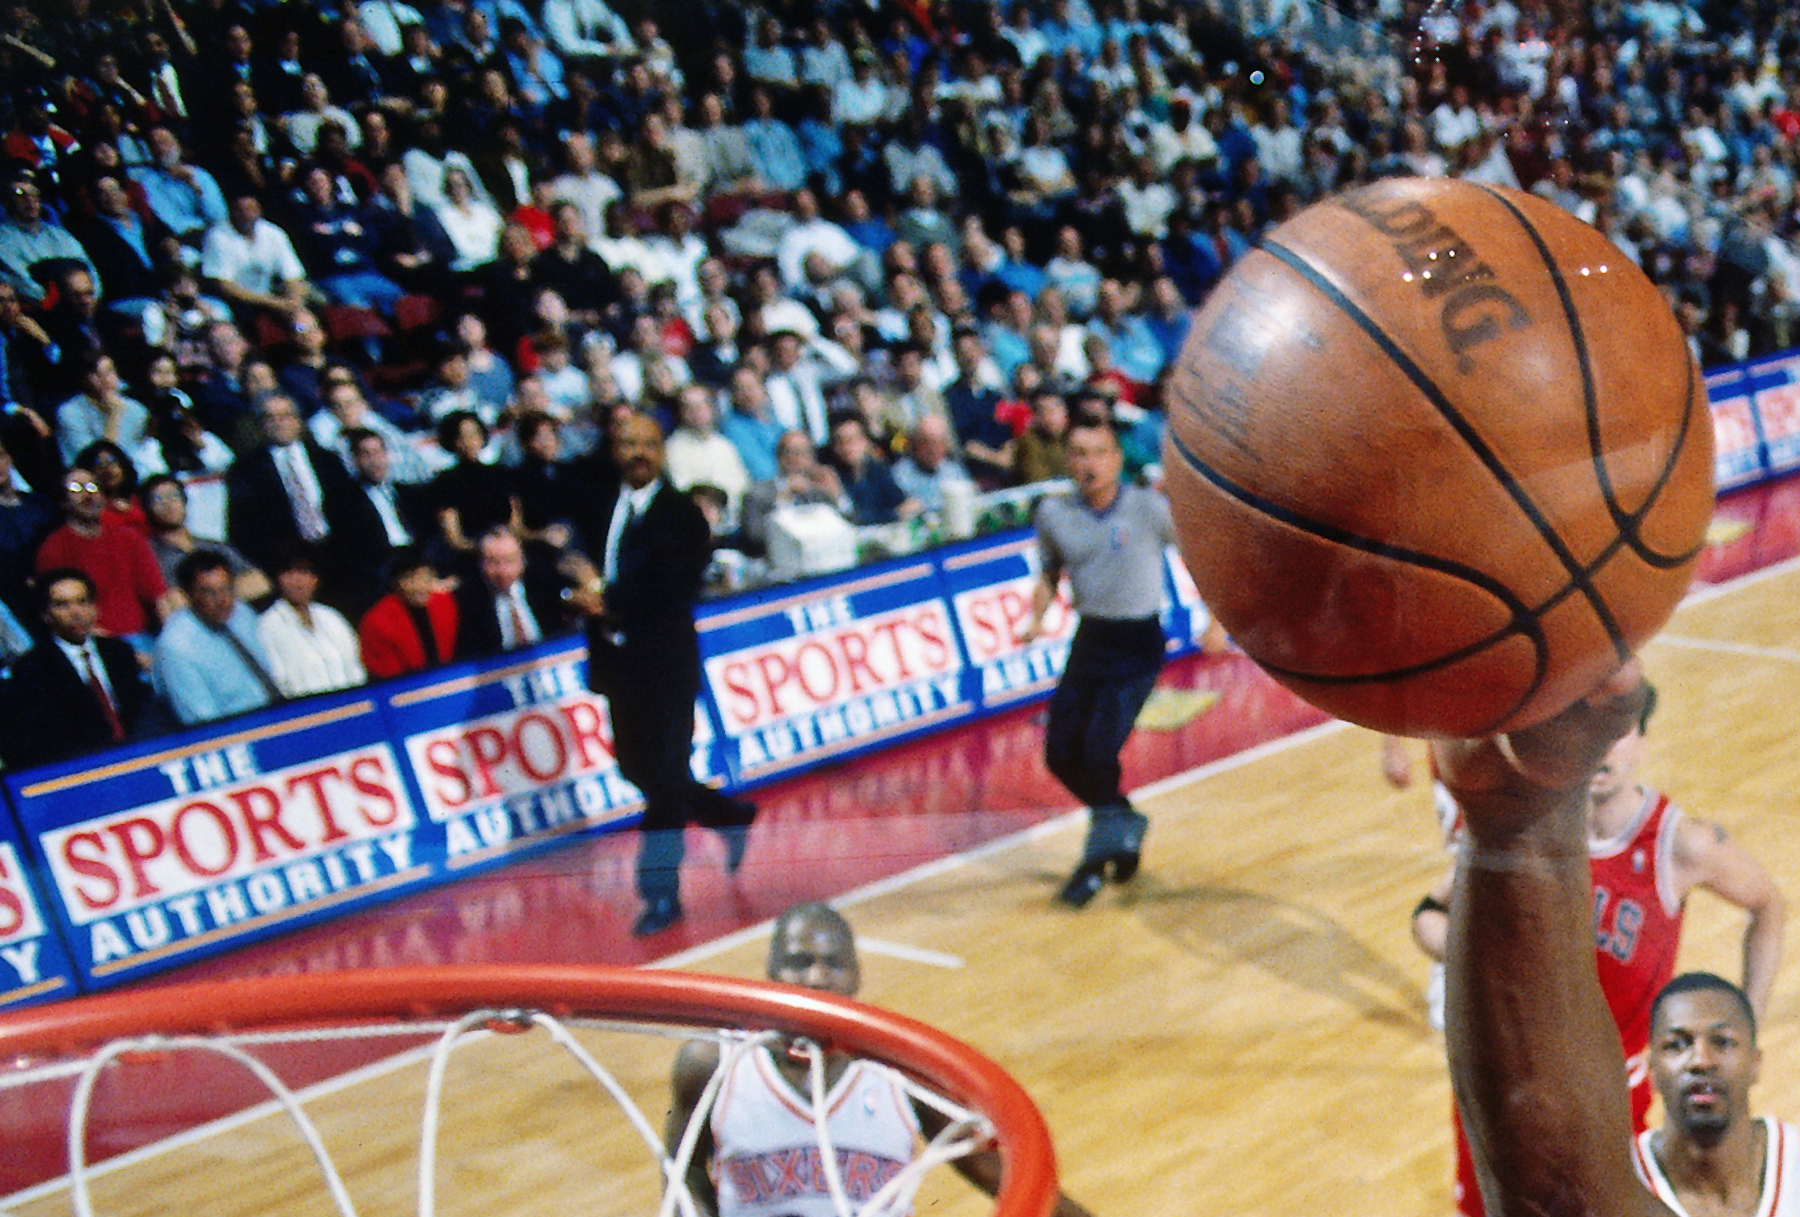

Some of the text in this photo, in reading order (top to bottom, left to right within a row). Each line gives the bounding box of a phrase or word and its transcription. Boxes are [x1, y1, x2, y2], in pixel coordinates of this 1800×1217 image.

[785, 596, 855, 635] THE
[506, 658, 587, 707] THE
[720, 608, 952, 728] SPORTS
[157, 742, 258, 796] THE
[739, 677, 963, 769] AUTHORITY
[60, 756, 400, 911] SPORTS
[90, 834, 412, 965] AUTHORITY
